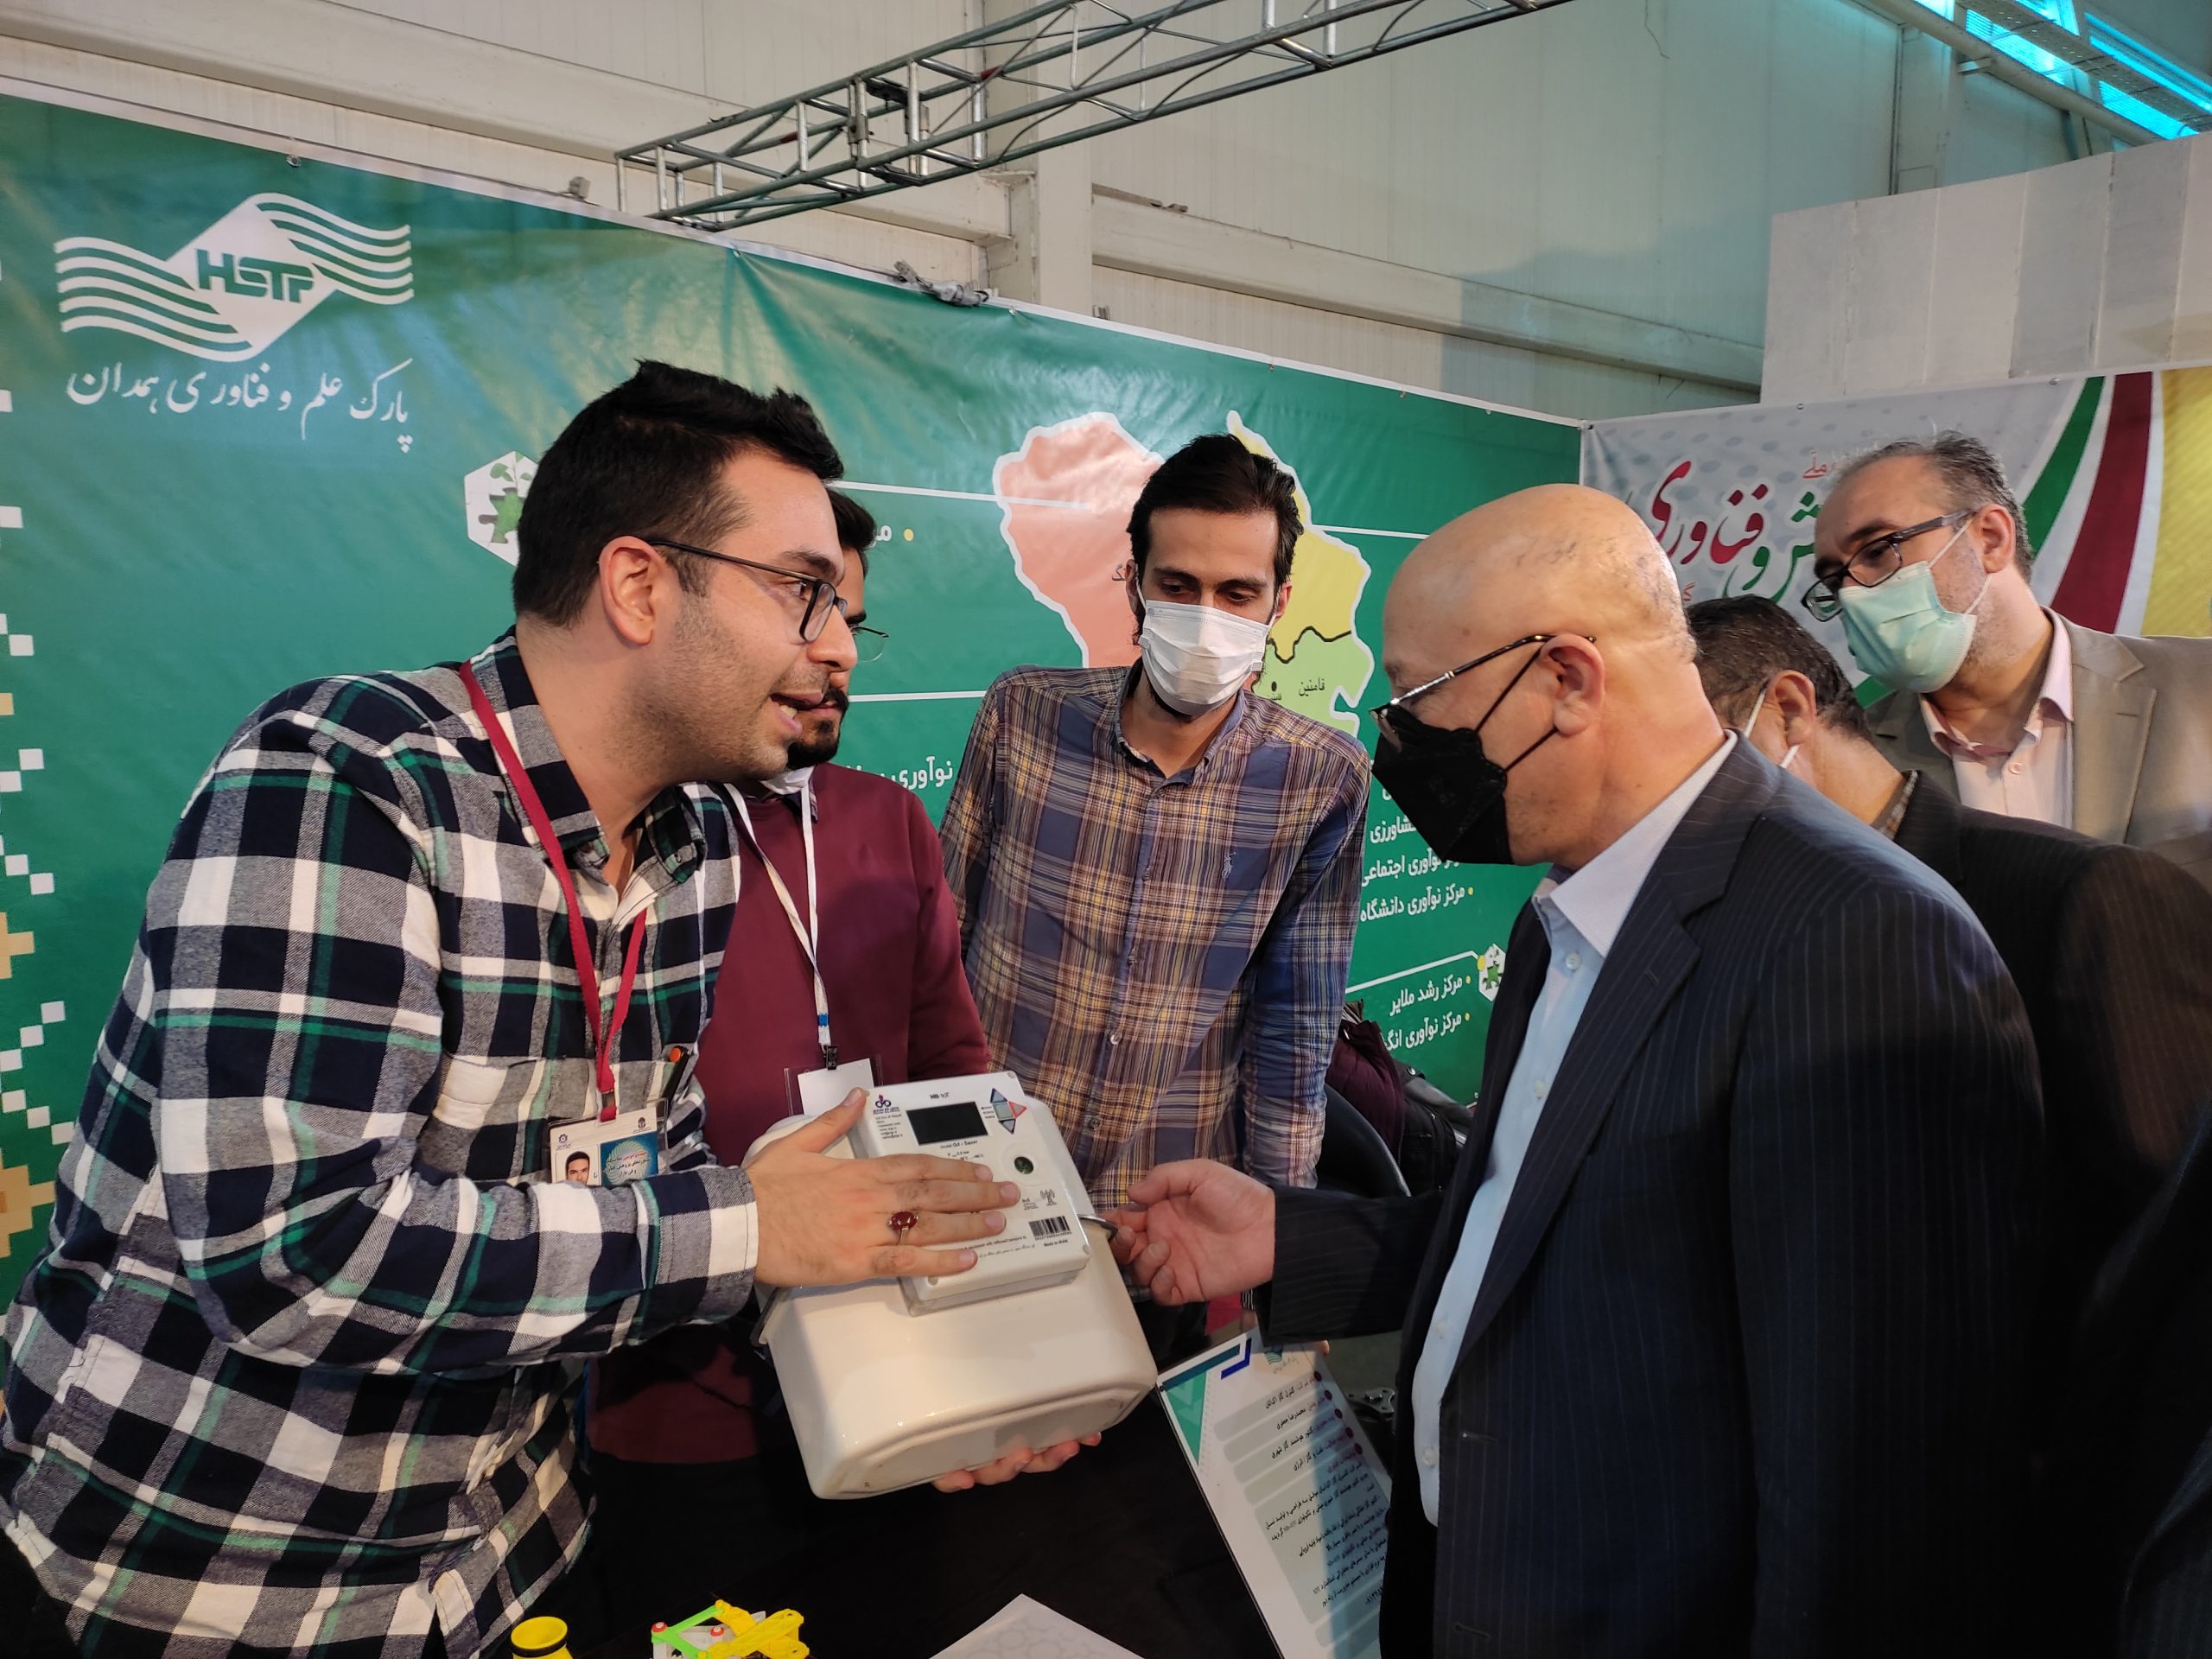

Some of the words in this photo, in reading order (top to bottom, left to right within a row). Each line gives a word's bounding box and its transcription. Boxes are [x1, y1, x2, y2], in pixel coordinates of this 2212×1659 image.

[195, 248, 315, 303] HSTP
[66, 362, 160, 415] همدان
[277, 387, 292, 410] و
[300, 372, 344, 441] علم
[349, 358, 413, 454] پارک
[899, 755, 953, 790] نوآوری
[1362, 855, 1405, 887] اجتماعی
[1360, 896, 1404, 922] دانشگاه
[1408, 886, 1441, 915] نوآوری
[1443, 883, 1465, 907] مرکز
[1417, 980, 1440, 1001] رشد
[1441, 974, 1463, 999] مرکز
[1389, 988, 1414, 1016] ملایر
[1405, 1017, 1439, 1049] نوآوری
[1440, 1011, 1462, 1036] مرکز
